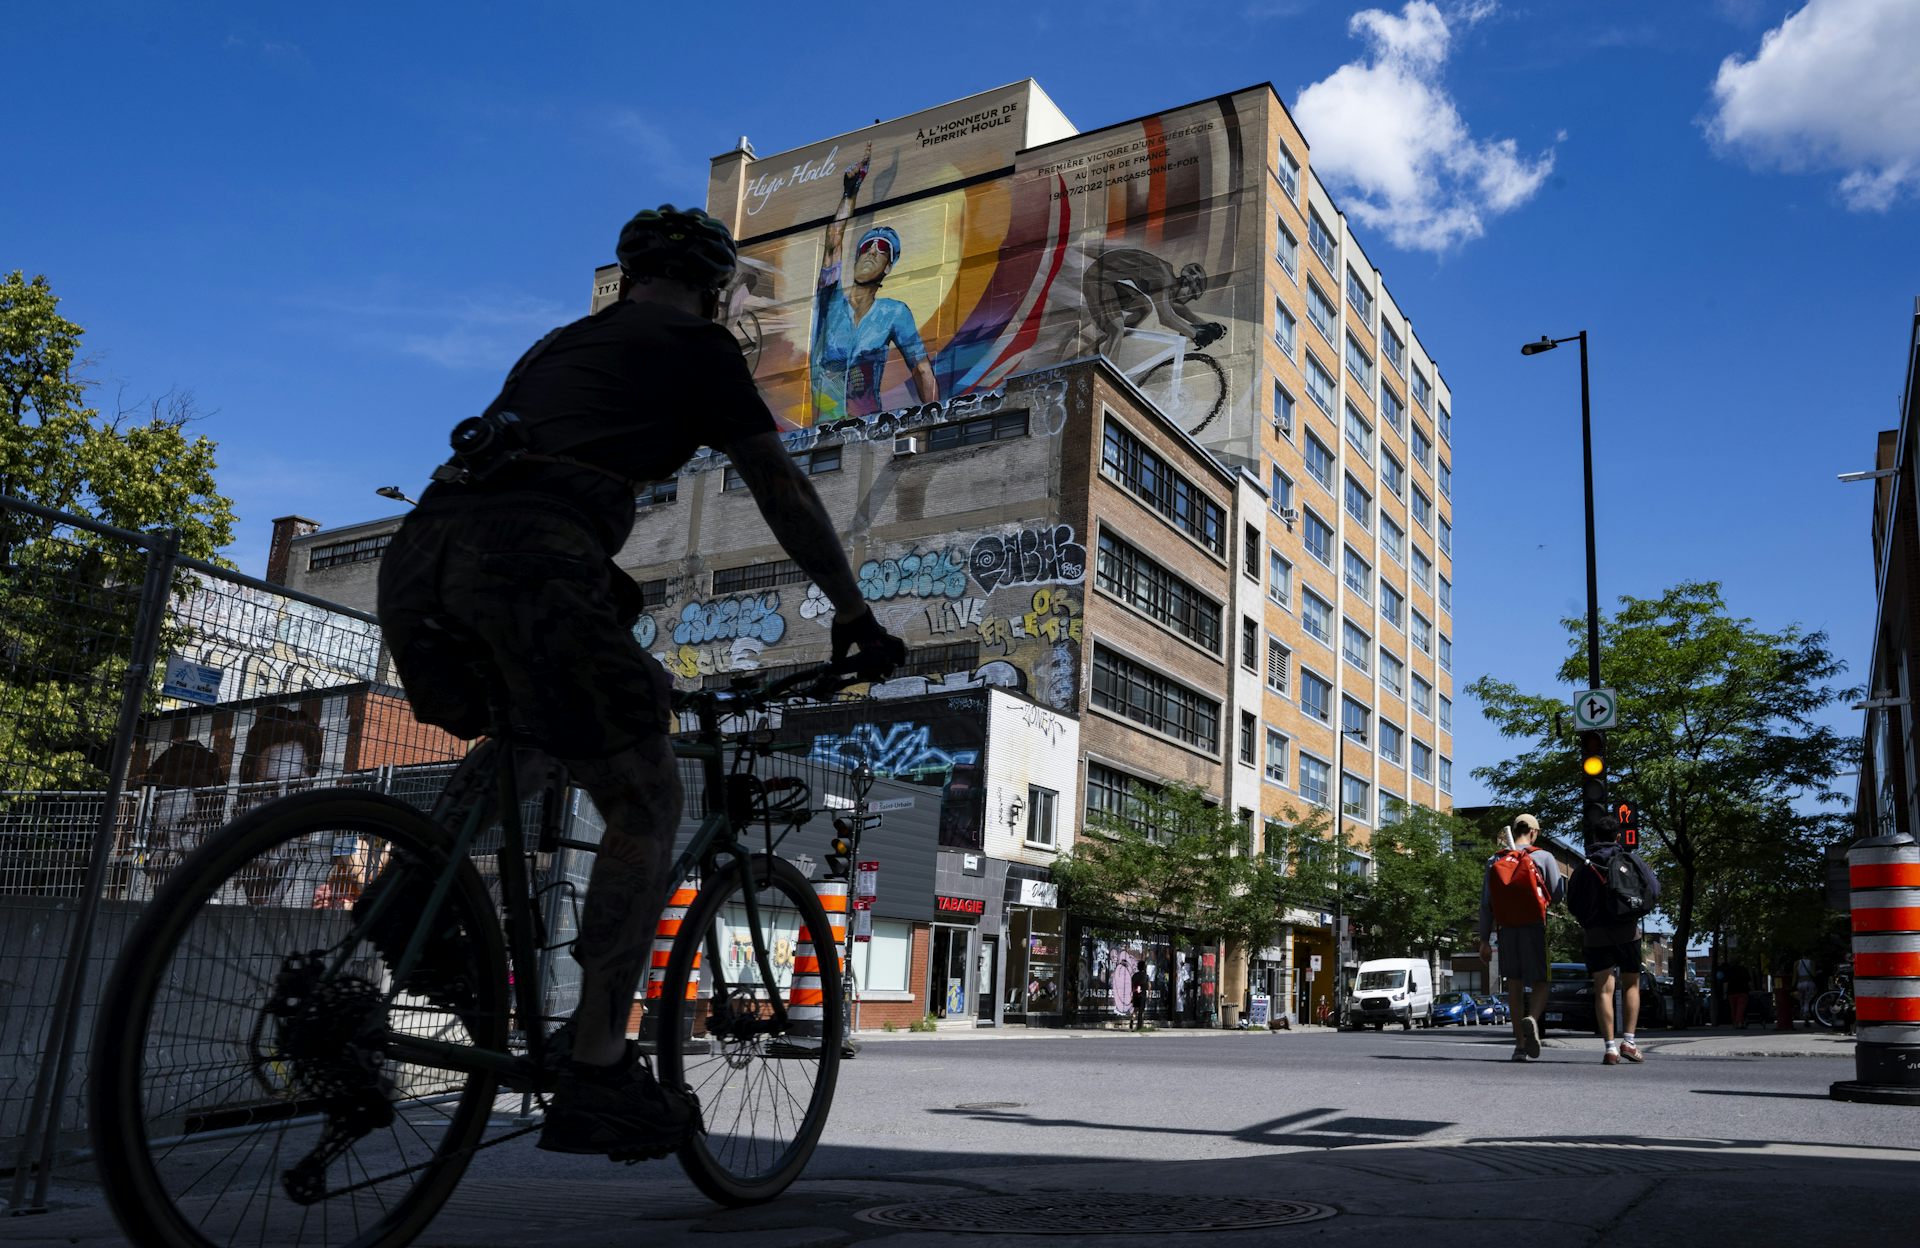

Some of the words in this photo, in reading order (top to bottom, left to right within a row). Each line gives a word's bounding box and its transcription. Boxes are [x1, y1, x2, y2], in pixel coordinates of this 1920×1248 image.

[916, 128, 925, 140] À
[929, 109, 998, 136] L'HONNEUR
[1002, 102, 1018, 114] DE
[922, 127, 968, 148] PIERRIK
[971, 115, 1012, 133] HOULE
[1038, 159, 1084, 177] PREMIÈRE
[1087, 145, 1129, 163] VICTOIRE
[1132, 137, 1155, 151] D'UN
[1158, 122, 1214, 144] QUÉBÉCOIS
[1075, 171, 1088, 181] AU
[1091, 165, 1116, 177] TOUR
[1118, 160, 1131, 169] DE
[1133, 148, 1171, 165] FRANCE
[742, 173, 785, 216] Hugo
[787, 145, 839, 187] Houle
[1105, 155, 1200, 186] CARCASSONNE-FOIX
[879, 801, 912, 810] Saint-Urbain
[938, 896, 983, 913] TABAGIE
